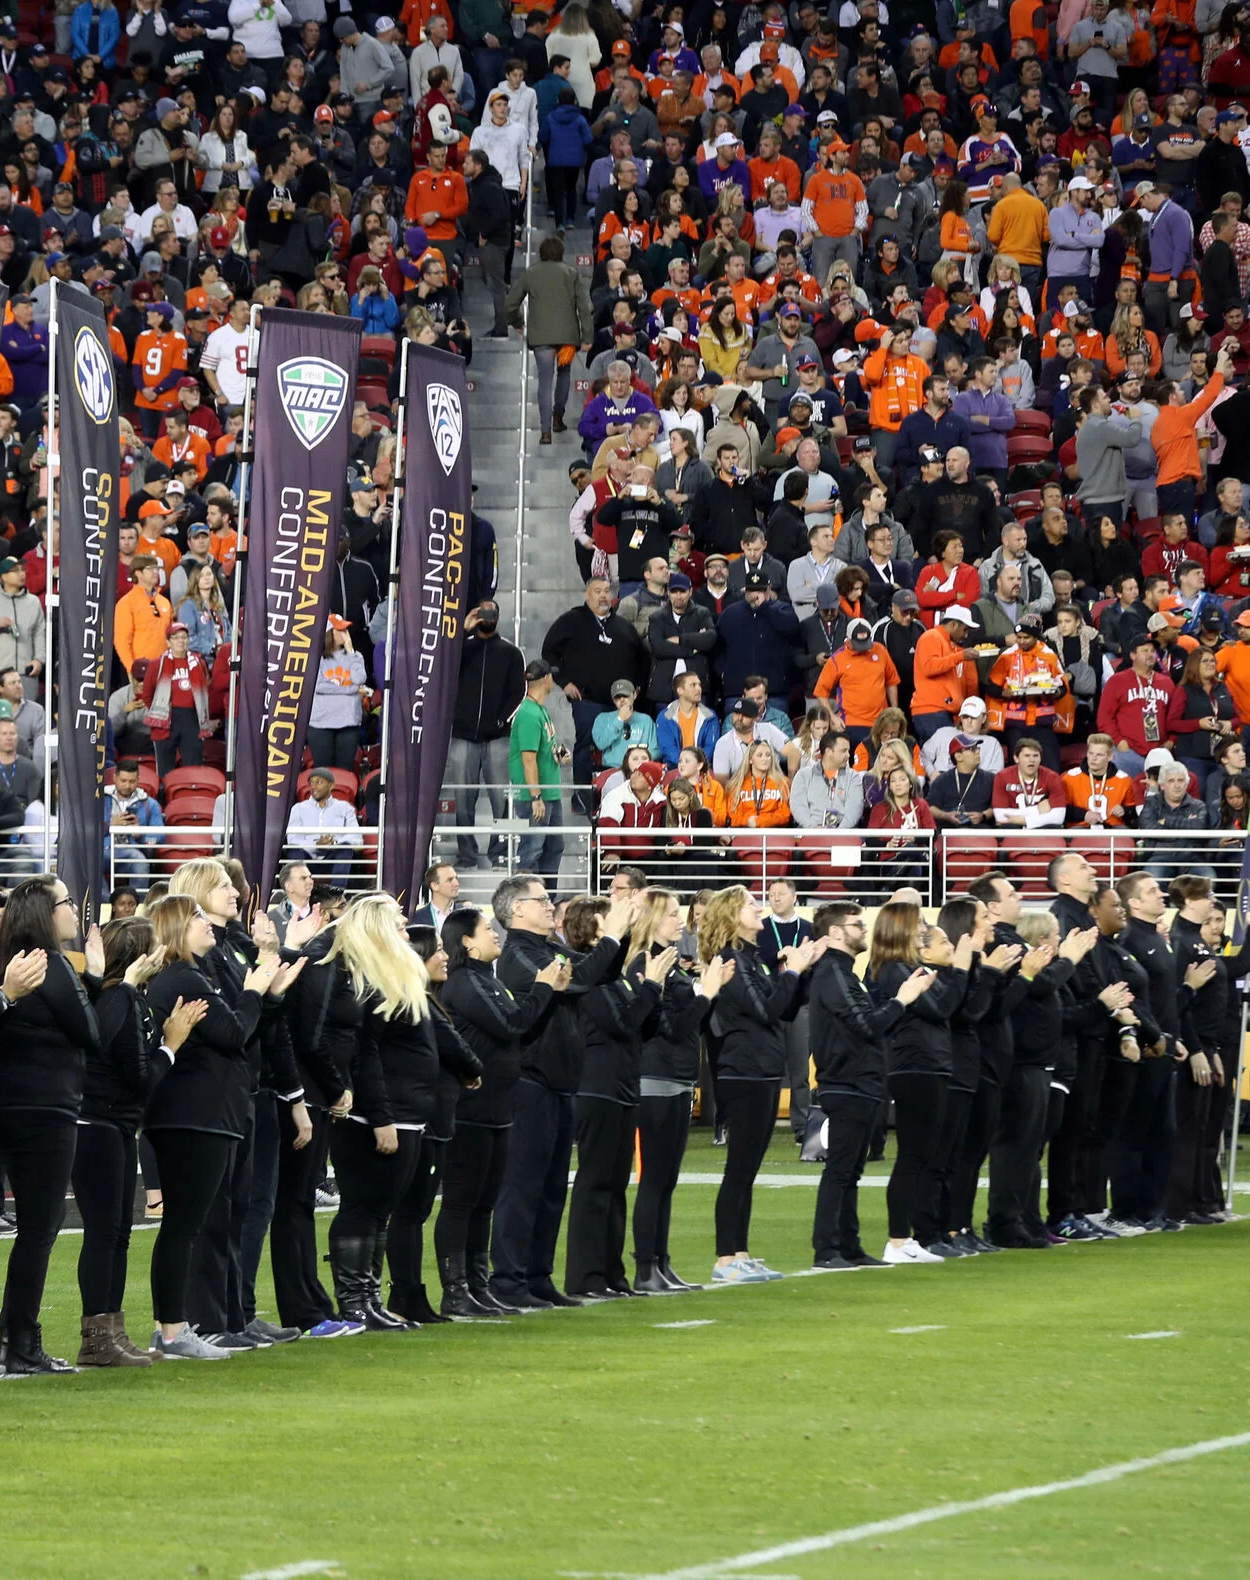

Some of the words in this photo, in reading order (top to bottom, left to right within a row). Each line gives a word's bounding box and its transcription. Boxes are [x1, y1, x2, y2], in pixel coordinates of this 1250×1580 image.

[145, 347, 163, 376] 9
[284, 384, 341, 411] MAC
[576, 381, 590, 391] 20
[440, 432, 454, 458] 12
[441, 511, 465, 640] PAC-12
[267, 489, 332, 798] MID-AMERICAN
[1087, 793, 1108, 821] 9
